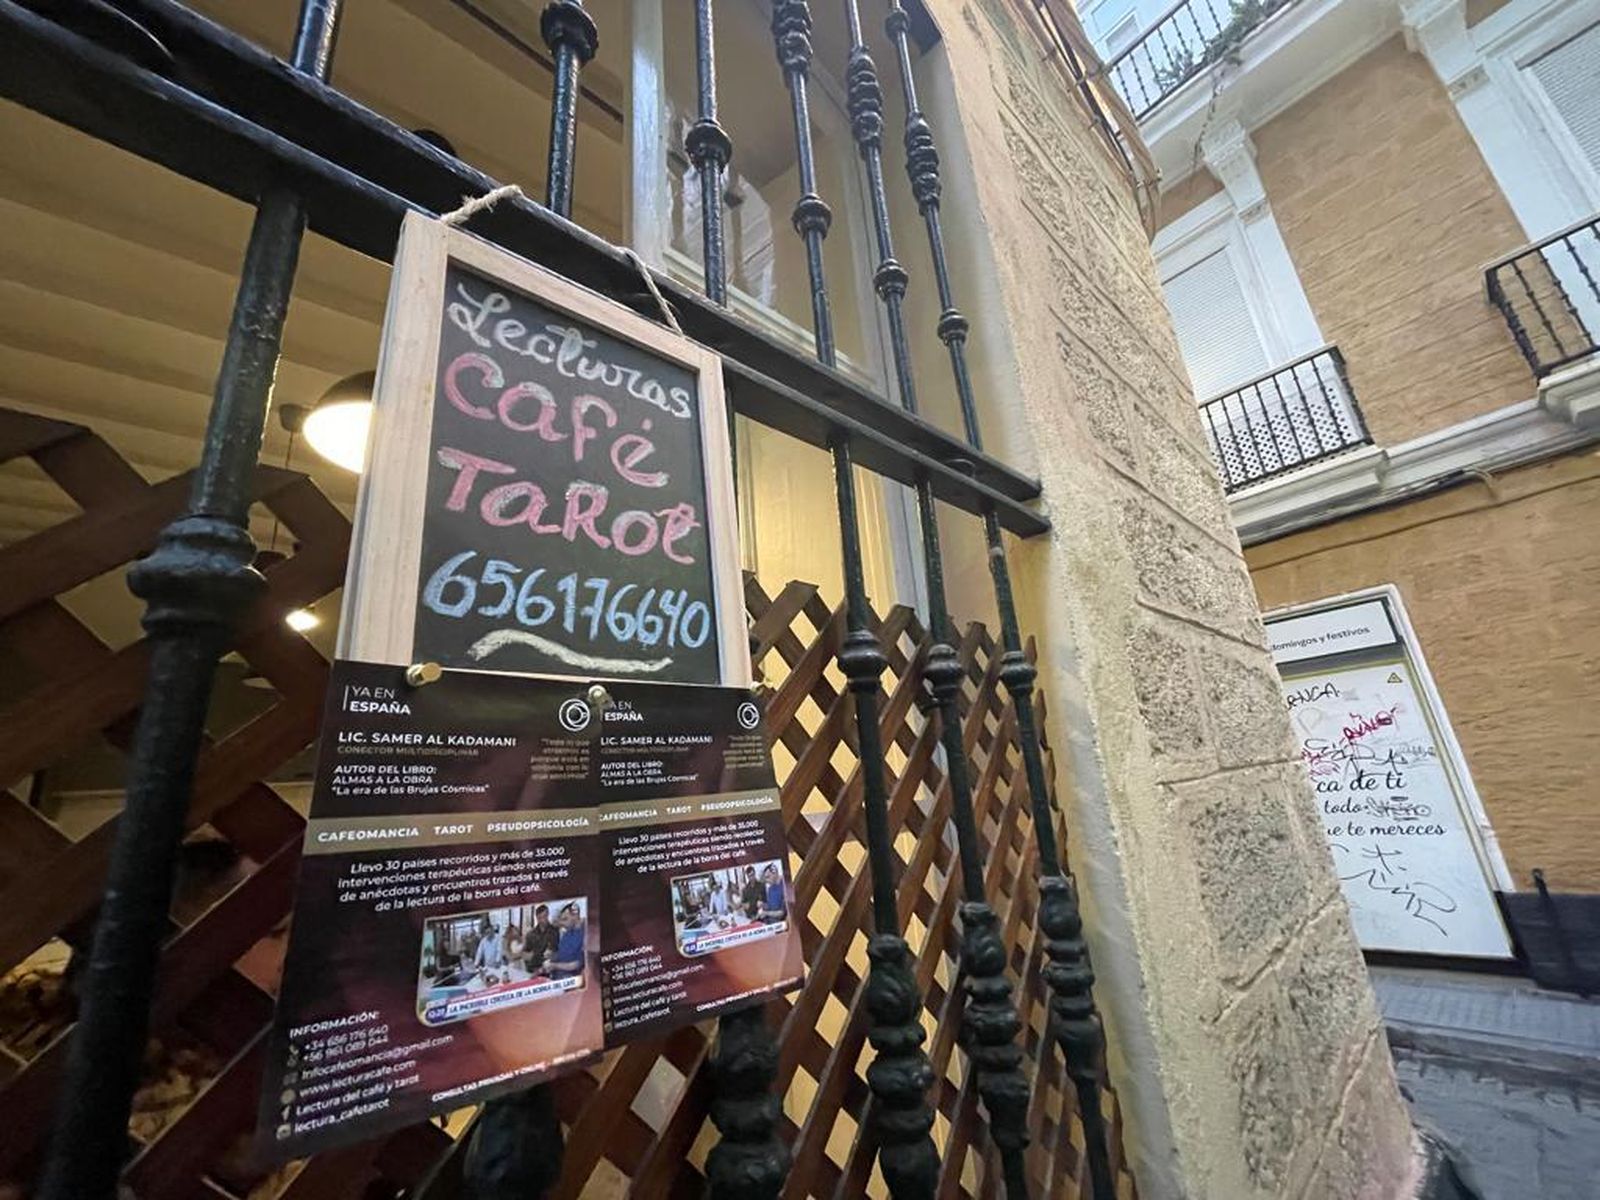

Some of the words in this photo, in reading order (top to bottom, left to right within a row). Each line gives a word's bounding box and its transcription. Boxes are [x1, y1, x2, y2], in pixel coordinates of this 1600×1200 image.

[447, 283, 692, 418] Lecturas
[423, 550, 711, 648] 656176640
[1326, 627, 1371, 640] festivos
[351, 686, 371, 698] YA
[374, 687, 395, 699] EN
[350, 700, 411, 715] ESPAÑA
[618, 700, 632, 710] EN
[604, 710, 644, 721] ESPAÑA
[338, 732, 367, 743] LIC.
[371, 732, 422, 745] SAMER
[426, 734, 444, 746] AL
[447, 735, 516, 747] KADAMANI
[600, 736, 618, 746] LIC.
[620, 736, 653, 745] SAMER
[654, 736, 666, 745] AL
[668, 735, 713, 744] KADAMANI
[333, 764, 376, 774] AUTOR
[378, 765, 400, 774] DEL
[402, 765, 437, 775] LIBRO:
[601, 762, 626, 771] AUTOR
[627, 761, 641, 769] DEL
[332, 775, 374, 785] ALMAS
[375, 776, 384, 785] A
[386, 776, 400, 785] LA
[402, 776, 433, 785] OBRA
[601, 770, 625, 779] ALMAS
[1317, 780, 1342, 792] ca
[1350, 769, 1379, 790] de
[1386, 772, 1407, 789] ti
[352, 787, 371, 795] era
[373, 786, 387, 795] de
[389, 786, 405, 795] las
[407, 785, 439, 796] Brujas
[666, 805, 692, 815] TAROT
[317, 827, 420, 843] CAFEOMANCIA
[434, 824, 474, 836] TAROT
[487, 816, 589, 833] PSEUDOPSICOLOGÍA
[1347, 821, 1366, 836] te
[1370, 824, 1447, 836] mereces
[351, 861, 383, 875] Llevo
[385, 859, 400, 871] 30
[402, 856, 437, 873] países
[439, 853, 491, 866] recorridos
[499, 848, 520, 861] más
[521, 848, 534, 859] de
[338, 870, 426, 889] intervenciones
[428, 863, 492, 881] terapéuticas
[493, 861, 525, 872] siendo
[526, 857, 571, 870] recolector
[339, 890, 359, 903] de
[360, 884, 421, 900] anécdotas
[422, 883, 431, 895] y
[431, 877, 491, 892] encuentros
[492, 872, 533, 885] trazados
[374, 901, 391, 913] de
[393, 899, 405, 911] la
[406, 894, 446, 909] lectura
[447, 892, 463, 904] de
[463, 889, 473, 900] la
[474, 887, 501, 899] borra
[503, 884, 519, 896] del
[368, 1024, 389, 1037] 640
[296, 1096, 341, 1117] Lectura
[342, 1090, 361, 1102] del
[395, 1074, 420, 1089] tarot
